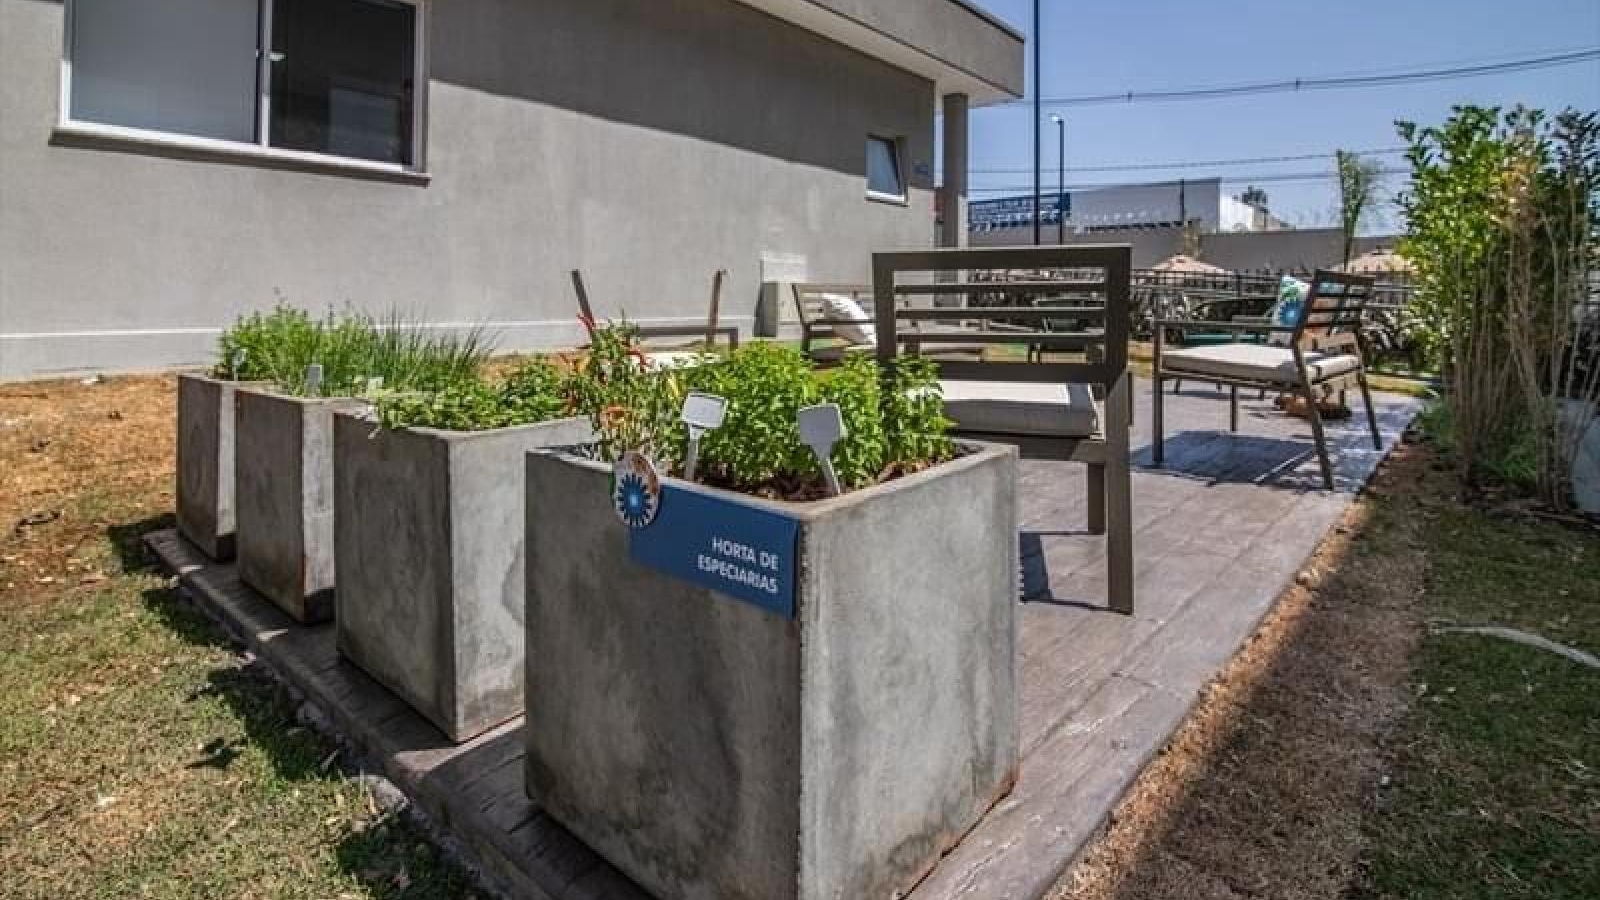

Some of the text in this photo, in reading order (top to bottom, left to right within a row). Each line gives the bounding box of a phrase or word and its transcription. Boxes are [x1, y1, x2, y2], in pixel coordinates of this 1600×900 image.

[712, 536, 779, 570] HORTA DE
[697, 554, 778, 594] ESPECIARIAS
